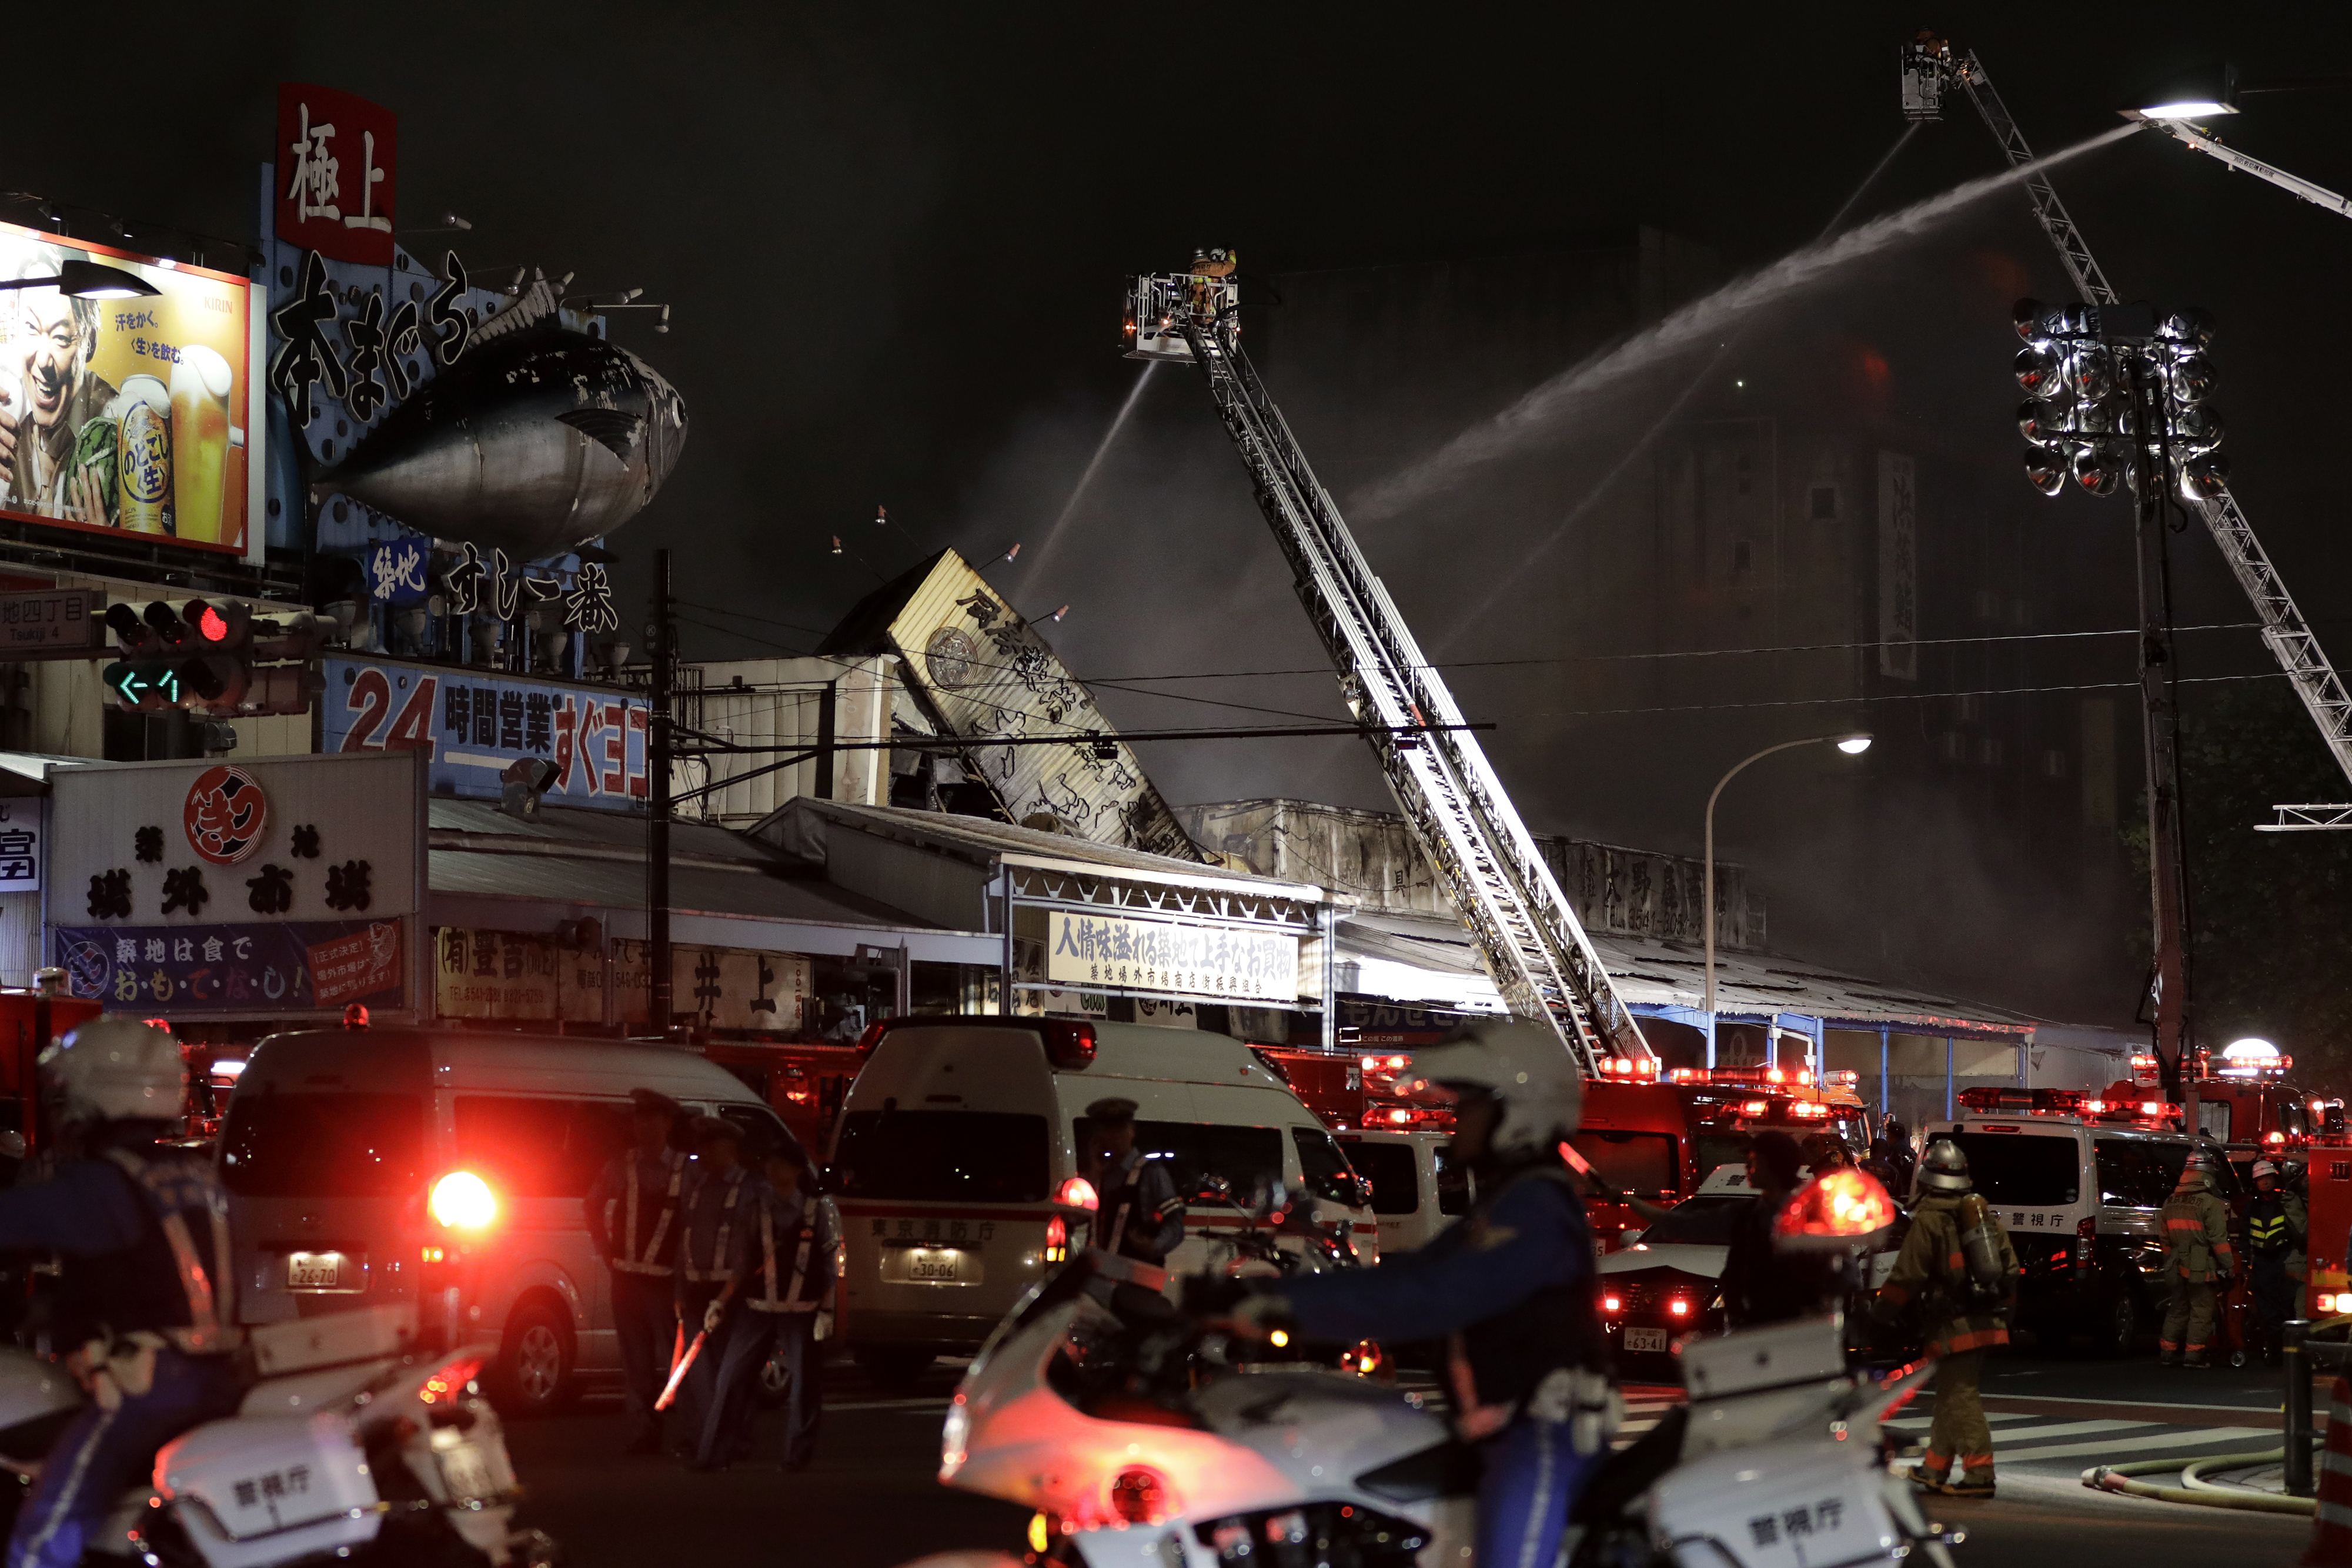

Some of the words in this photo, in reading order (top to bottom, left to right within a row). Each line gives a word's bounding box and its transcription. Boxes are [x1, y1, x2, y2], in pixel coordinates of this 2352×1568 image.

[288, 103, 392, 233] 極上
[205, 296, 233, 314] KIRIN
[115, 310, 158, 332] 汗をかく。
[269, 249, 468, 429] 本まぐろ
[372, 544, 426, 600] 築地
[446, 541, 619, 634] すし一番
[2, 597, 82, 624] 地四丁目
[10, 627, 46, 642] Tsukiji
[52, 627, 59, 638] 4
[86, 859, 372, 920] 場外市場
[116, 935, 253, 964] 築地は食で
[694, 951, 777, 1015] 井上
[1090, 963, 1262, 994] 築地場外市場商店街振興組合
[873, 1218, 995, 1241] 東京消防庁
[2012, 1212, 2064, 1227] 警視庁
[299, 1269, 335, 1283] 26-70
[920, 1264, 954, 1276] 30-06
[1633, 1337, 1662, 1350] 63-41
[232, 1463, 310, 1508] 警視庁
[1747, 1497, 1845, 1547] 警視庁
